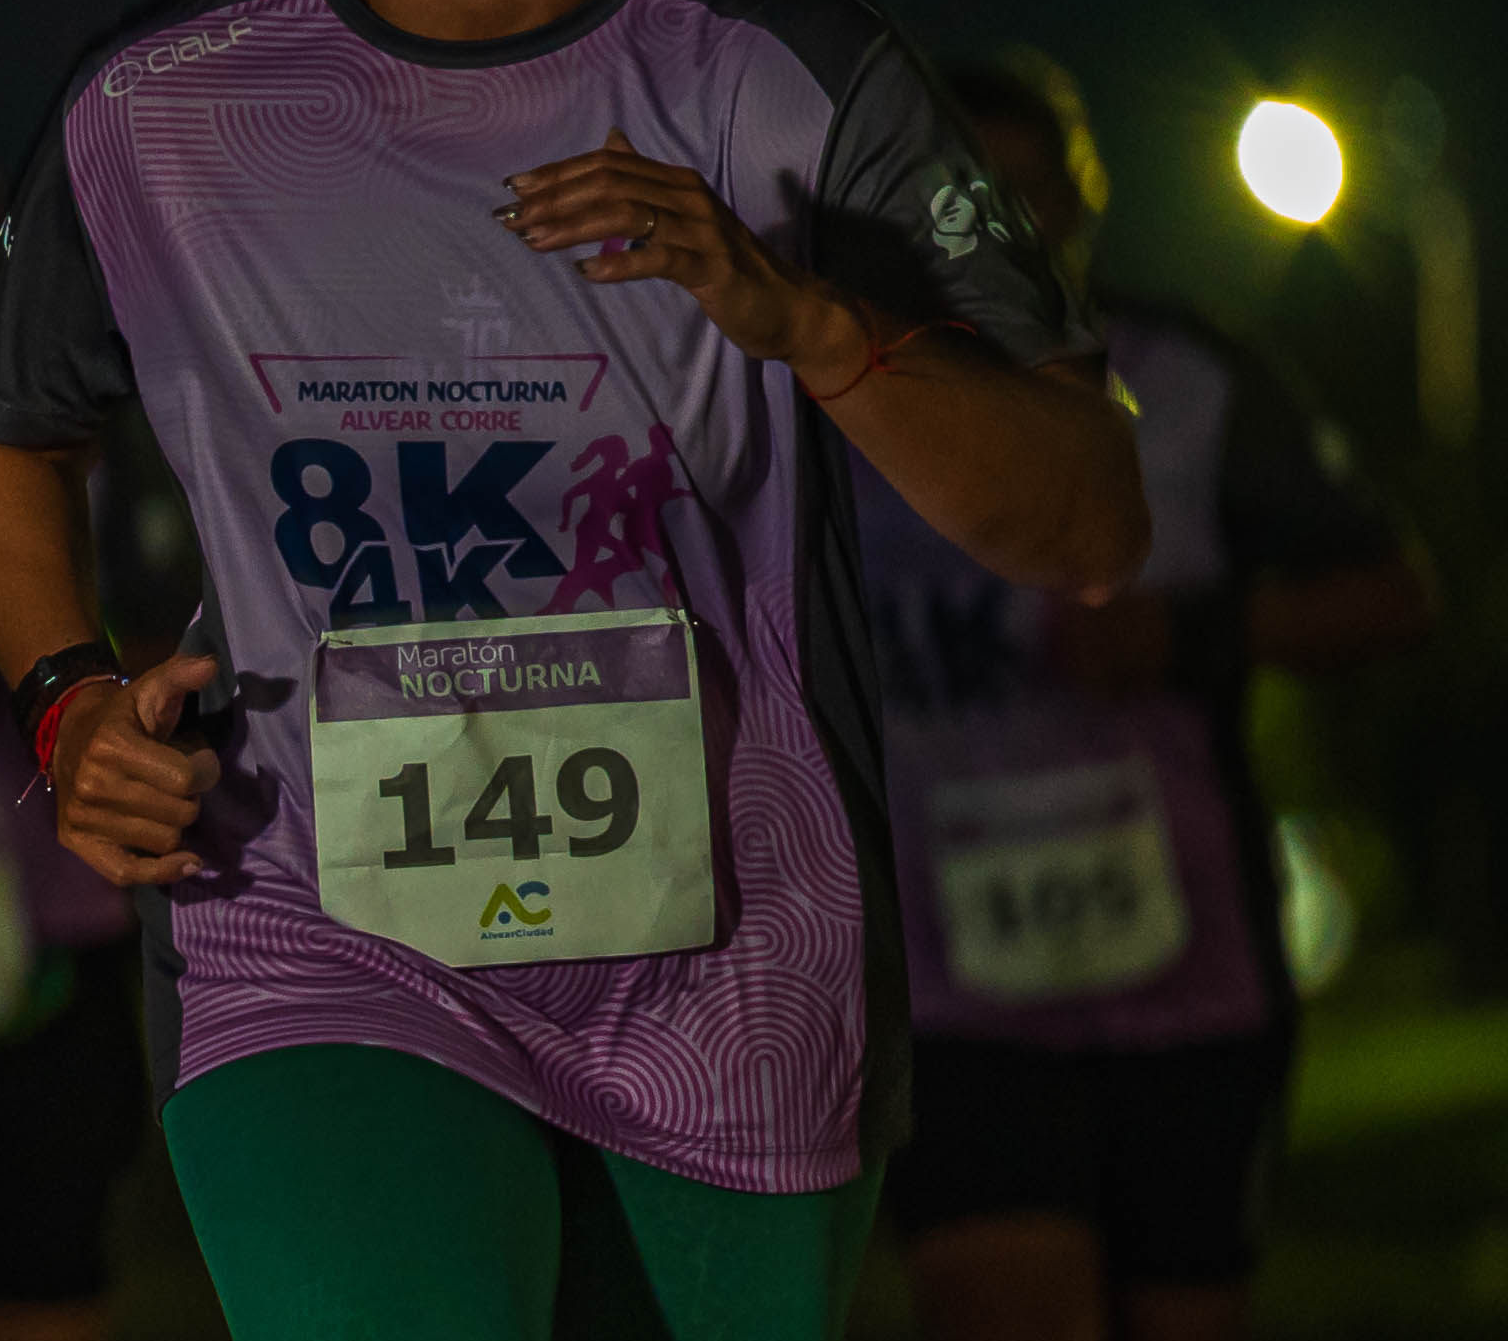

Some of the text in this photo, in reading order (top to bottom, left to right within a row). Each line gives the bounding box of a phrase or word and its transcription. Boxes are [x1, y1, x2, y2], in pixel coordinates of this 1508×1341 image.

[297, 380, 567, 403] MARATON NOCTURNA
[339, 410, 523, 432] ALVEAR CORRE
[270, 437, 572, 590] 8K
[328, 540, 510, 631] 4K
[396, 636, 516, 672] Maratón
[399, 660, 602, 700] NOCTURNA
[379, 746, 640, 870] 149
[480, 927, 555, 941] AlvearCiudad
